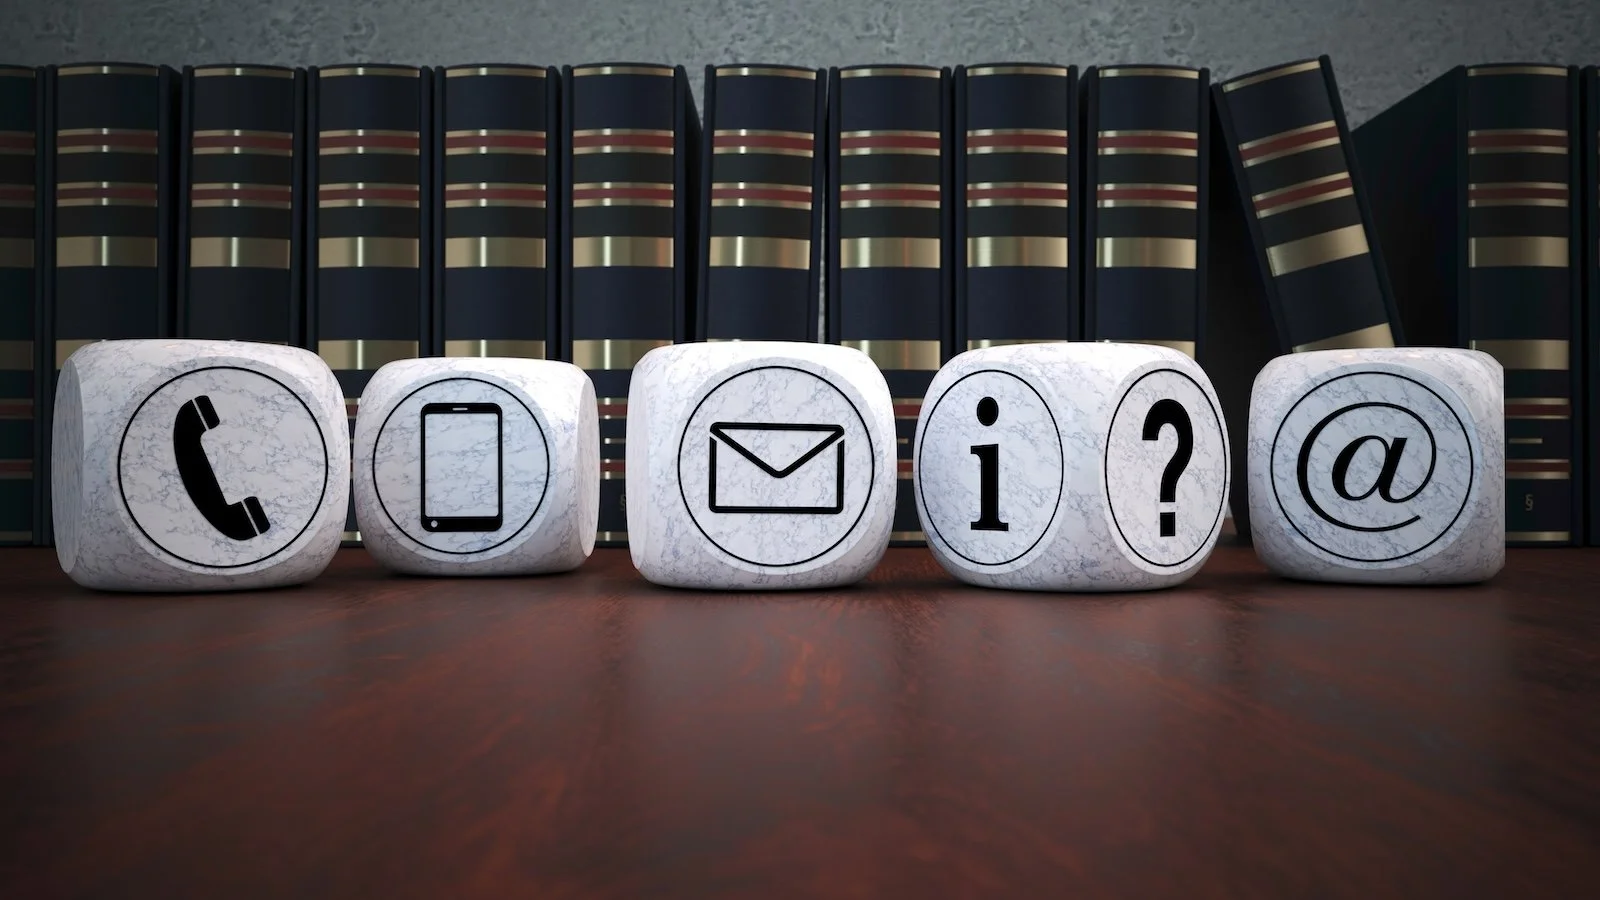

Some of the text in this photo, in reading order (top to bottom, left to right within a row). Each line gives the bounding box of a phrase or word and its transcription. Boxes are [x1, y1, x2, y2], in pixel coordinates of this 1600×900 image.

[971, 397, 1009, 531] i
[1142, 399, 1194, 538] ?
[1297, 402, 1437, 533] @
[1525, 494, 1534, 511] §
